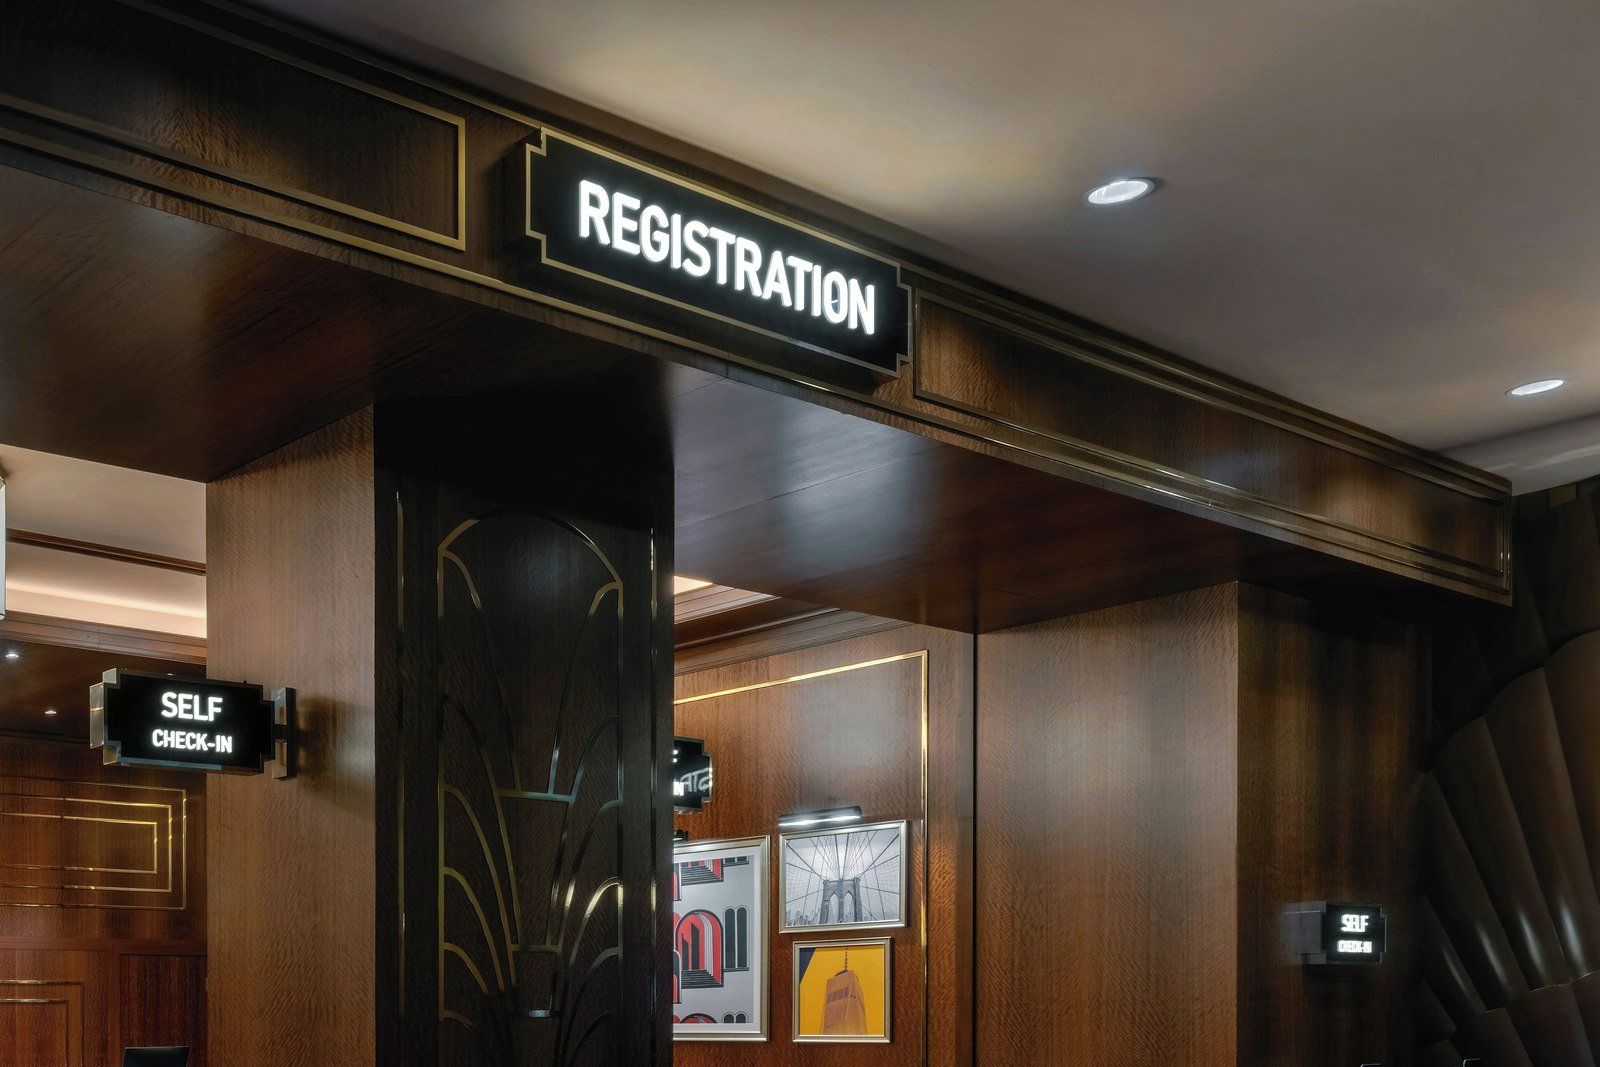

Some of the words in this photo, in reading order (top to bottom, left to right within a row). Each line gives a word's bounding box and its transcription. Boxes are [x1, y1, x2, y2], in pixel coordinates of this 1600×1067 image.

[578, 179, 876, 335] REGISTRATION
[161, 691, 223, 722] SELF
[152, 728, 233, 753] CHECK-IN
[1341, 914, 1369, 933] SELF
